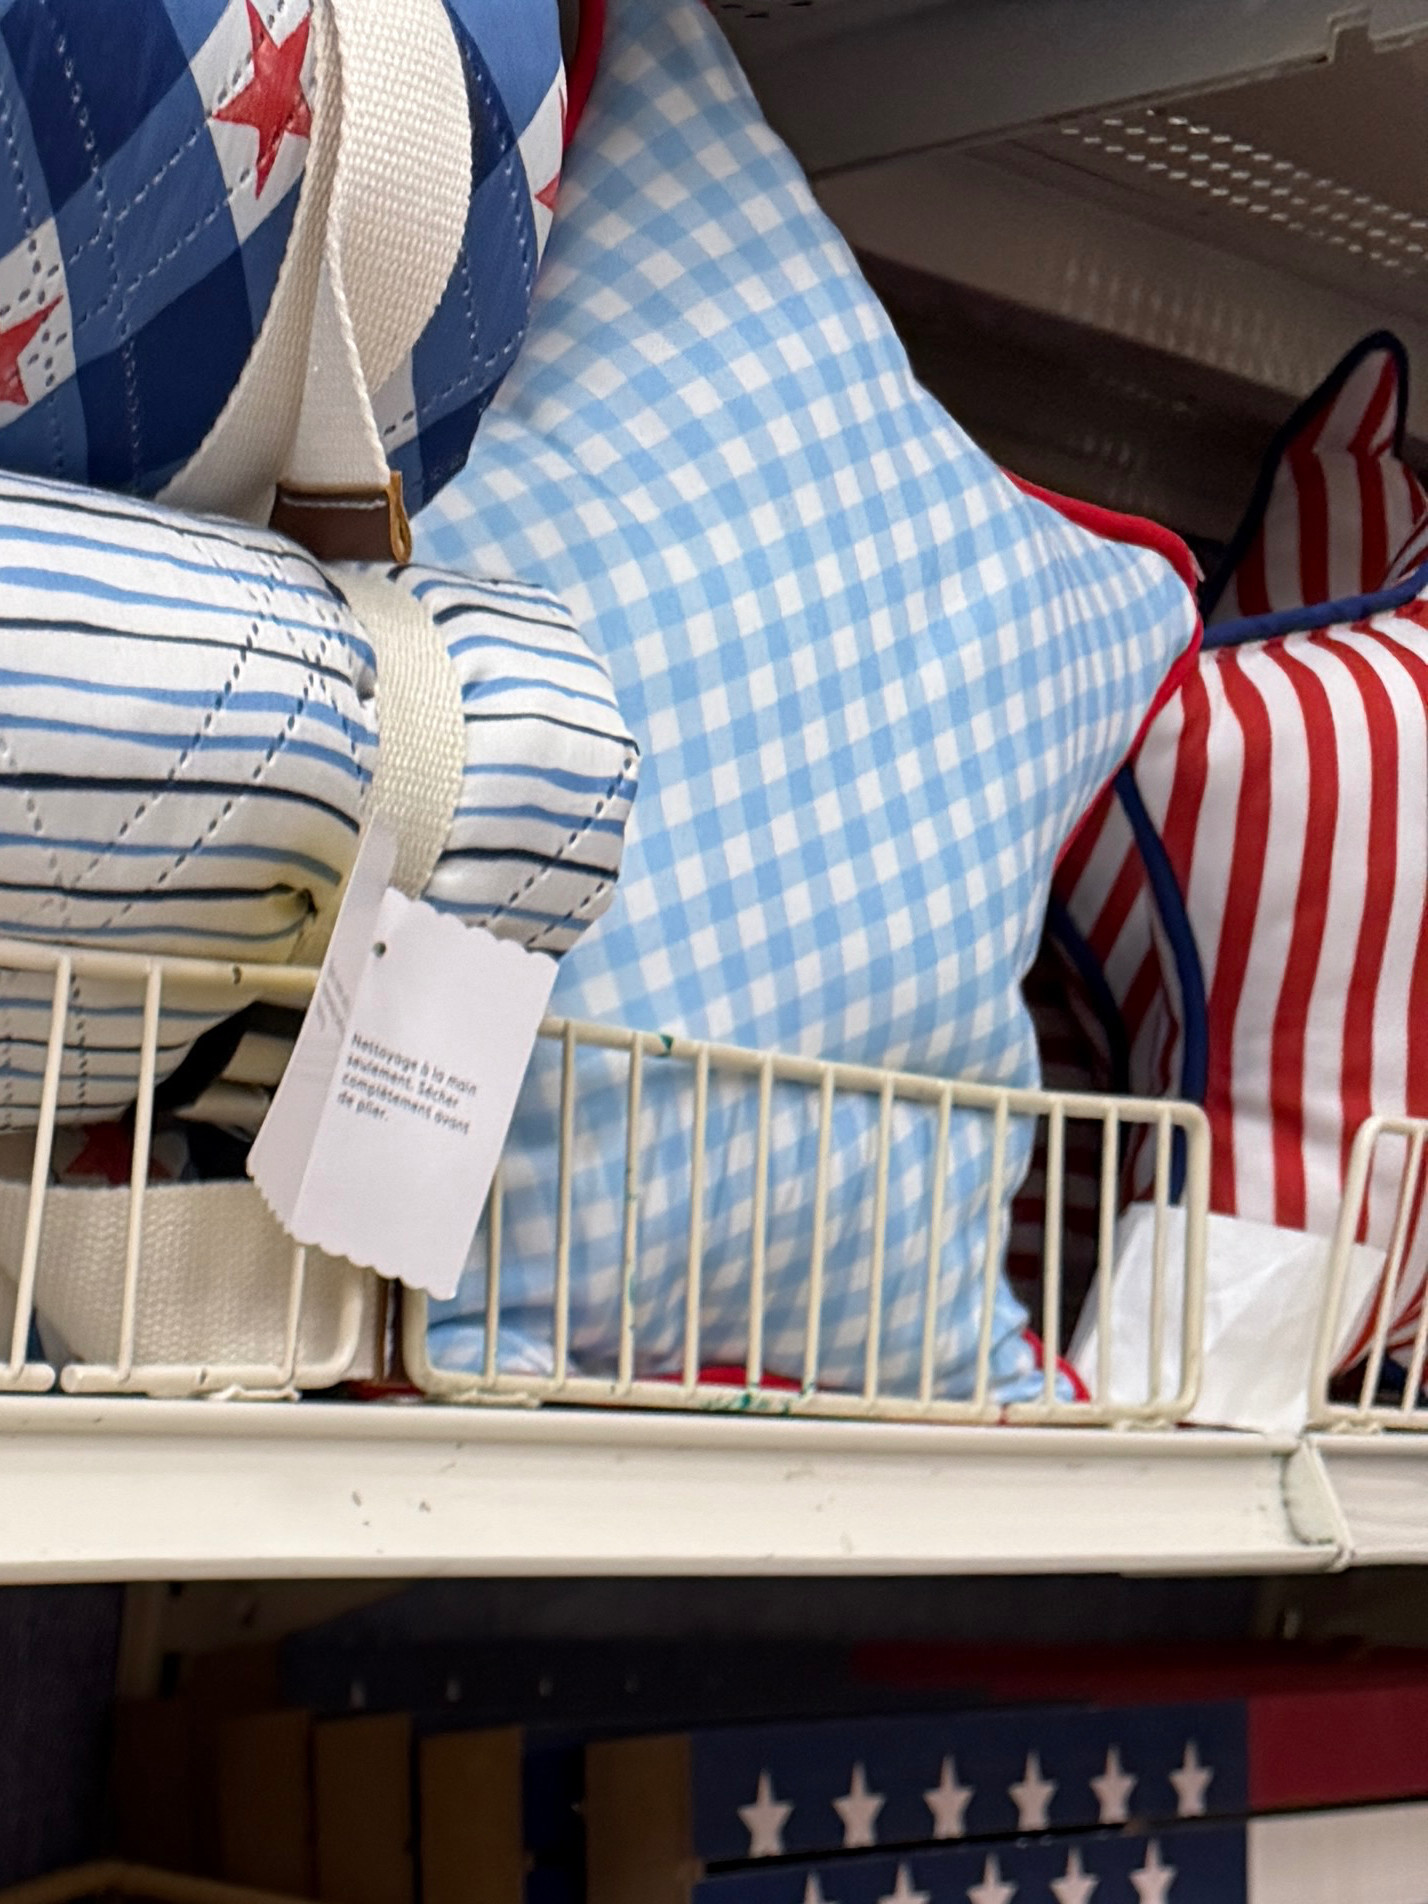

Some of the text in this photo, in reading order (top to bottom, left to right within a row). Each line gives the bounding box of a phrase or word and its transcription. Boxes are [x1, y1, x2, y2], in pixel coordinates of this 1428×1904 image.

[346, 1055, 459, 1108] seulement. Sécher
[351, 1032, 418, 1073] Nettoyage
[431, 1065, 445, 1084] la
[446, 1075, 477, 1097] main
[337, 1091, 388, 1121] de plier.
[342, 1073, 470, 1135] complètement avant
